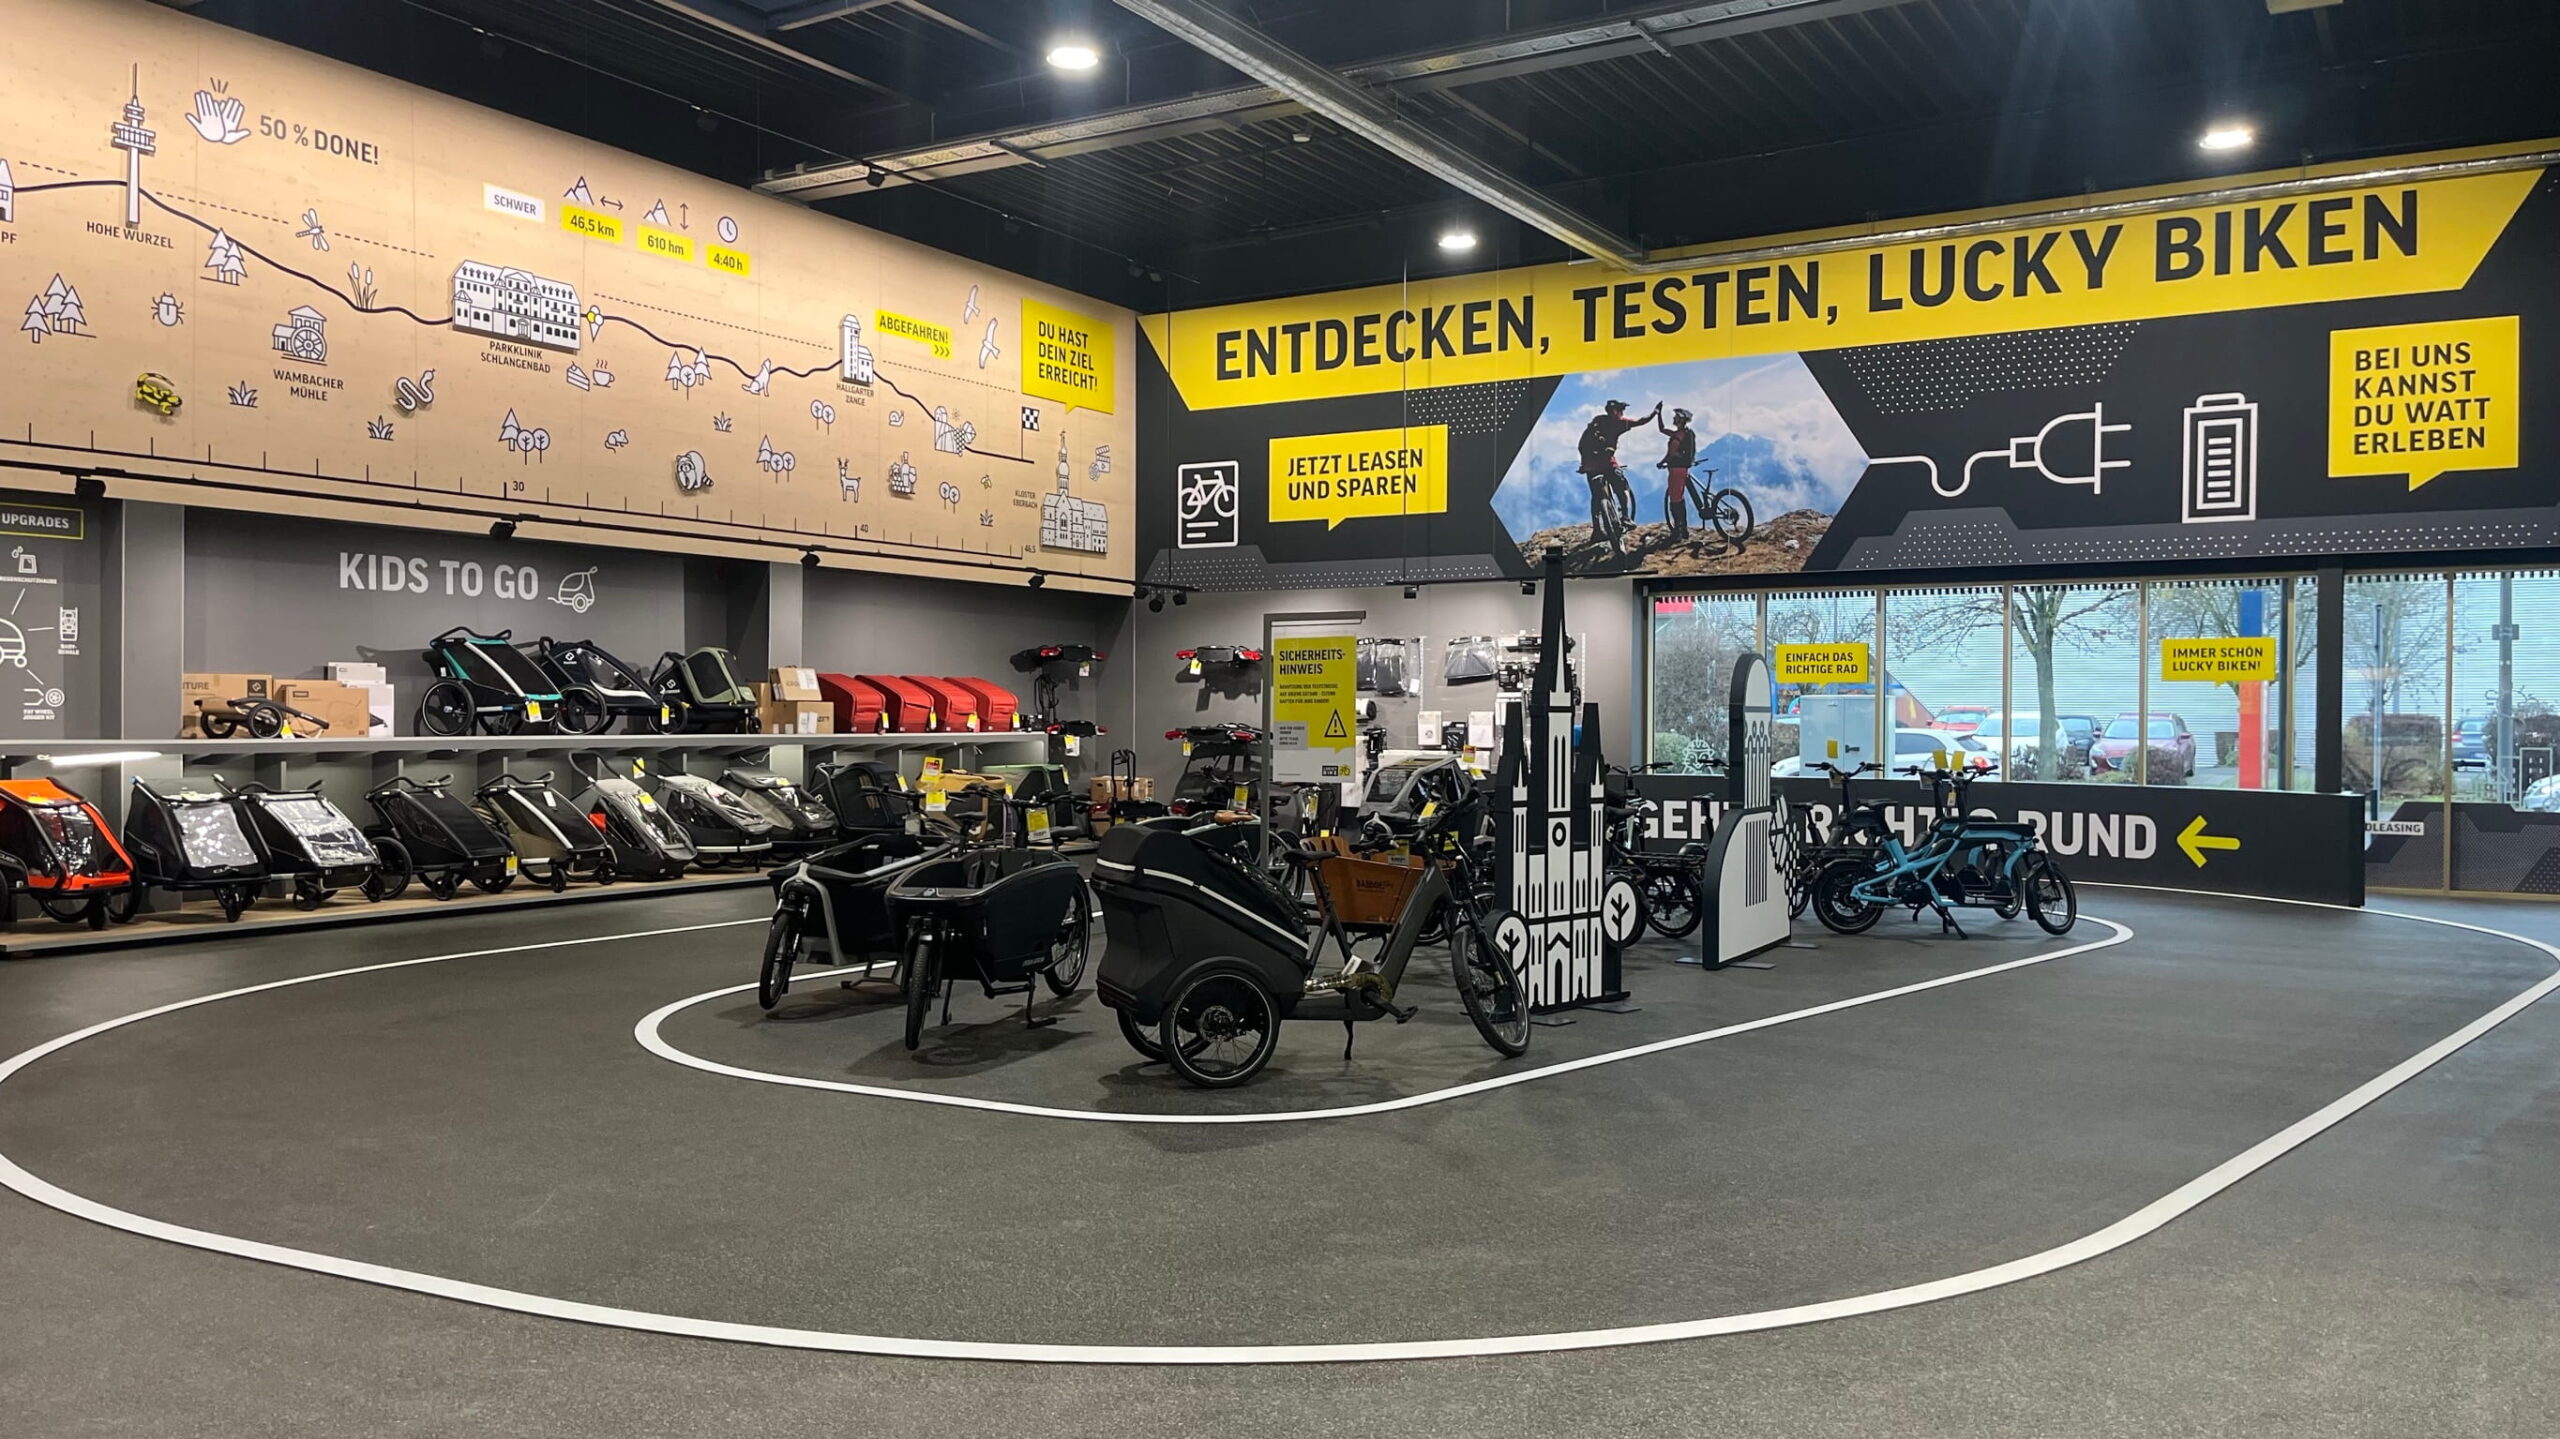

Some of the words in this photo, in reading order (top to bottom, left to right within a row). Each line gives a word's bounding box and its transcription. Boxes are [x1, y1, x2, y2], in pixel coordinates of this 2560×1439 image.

[260, 114, 287, 140] 50
[293, 123, 309, 147] %
[314, 128, 379, 165] DONE!
[494, 194, 537, 216] SCHWER
[86, 221, 120, 238] HOHE
[123, 228, 174, 249] WURZEL
[570, 214, 595, 232] 46,5
[598, 220, 615, 237] km
[647, 234, 666, 250] 610
[668, 241, 685, 256] hm
[713, 252, 735, 268] 4:40
[736, 259, 743, 271] h
[1216, 295, 1549, 381] ENTDECKEN,
[1573, 261, 1837, 342] TESTEN,
[1868, 224, 2124, 312] LUCKY
[2155, 190, 2418, 282] BIKEN
[880, 315, 948, 344] ABGEFAHREN!
[1039, 320, 1055, 340] DU
[1059, 326, 1088, 349] HAST
[489, 340, 543, 359] PARKKLINIK
[1039, 341, 1066, 363] DEIN
[1070, 349, 1094, 371] ZIEL
[2355, 347, 2399, 371] BEI
[2412, 342, 2471, 367] UNS
[480, 352, 551, 373] SCHLANGENBAD
[273, 368, 344, 390] WAMBACHER
[1039, 362, 1098, 392] ERREICHT!
[2355, 370, 2476, 399] KANNST
[290, 385, 328, 401] MÜHLE
[836, 383, 874, 397] HALLGARTER
[846, 395, 865, 406] ZANGE
[2354, 404, 2393, 427] DU
[2405, 397, 2491, 424] WATT
[2354, 426, 2485, 455] ERLEBEN
[1288, 455, 1342, 477] JETZT
[1348, 448, 1423, 472] LEASEN
[512, 480, 525, 492] 30
[1288, 480, 1329, 501] UND
[1336, 474, 1416, 498] SPAREN
[1, 512, 70, 529] UPGRADES
[860, 524, 869, 533] 40
[339, 552, 429, 593] KIDS
[439, 559, 483, 597] TO
[494, 564, 539, 600] GO
[1279, 649, 1346, 661] SICHERHEITS-
[1786, 653, 1829, 662] EINFACH
[1833, 652, 1853, 662] DAS
[2173, 647, 2216, 658] IMMER
[2220, 646, 2263, 658] SCHÖN
[1279, 663, 1323, 675] HINWEIS
[1786, 664, 1833, 674] RICHTIGE
[1836, 664, 1858, 674] RAD
[2173, 661, 2213, 671] LUCKY
[2217, 660, 2260, 671] BIKEN!
[1638, 799, 1729, 839] GEH
[2018, 810, 2157, 859] RUND
